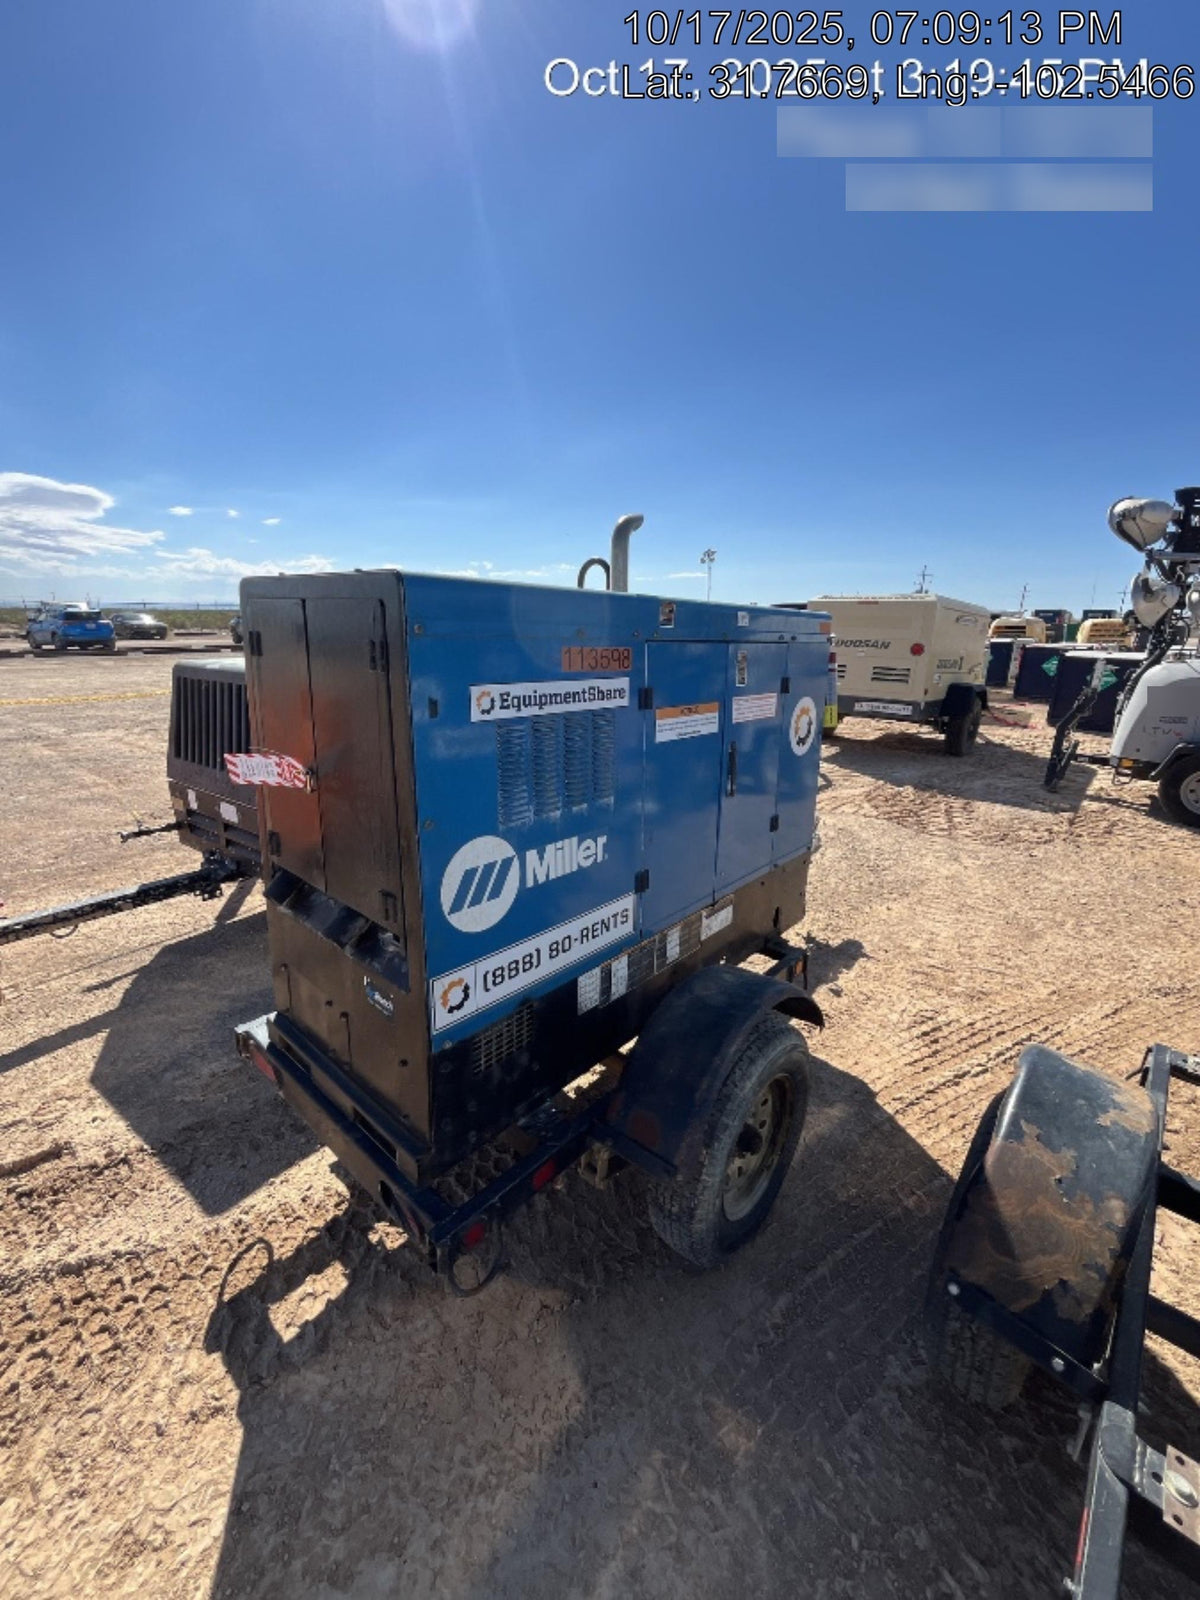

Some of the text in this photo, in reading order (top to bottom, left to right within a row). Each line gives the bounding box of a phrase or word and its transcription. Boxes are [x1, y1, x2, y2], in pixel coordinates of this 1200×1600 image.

[499, 685, 626, 712] EquipmentShare
[525, 834, 608, 888] Miller
[483, 947, 542, 993] (888)
[549, 908, 629, 960] 80-RENTS
